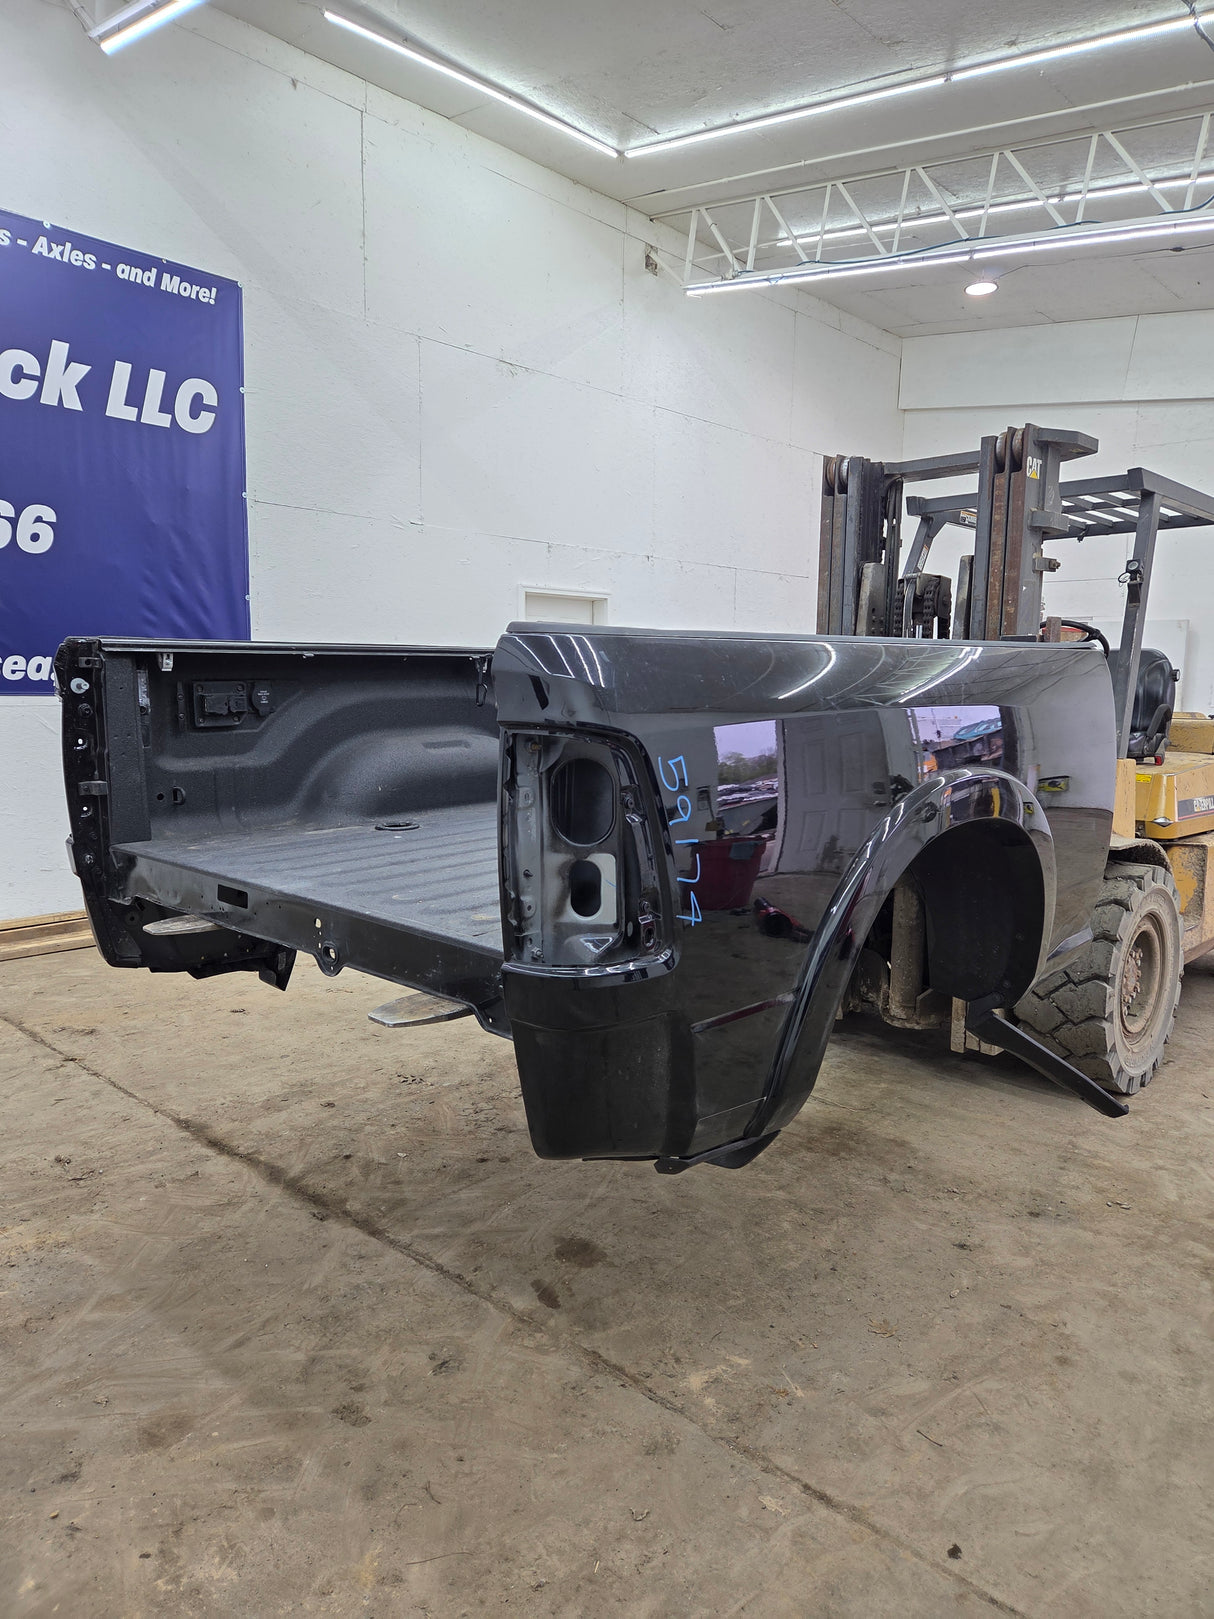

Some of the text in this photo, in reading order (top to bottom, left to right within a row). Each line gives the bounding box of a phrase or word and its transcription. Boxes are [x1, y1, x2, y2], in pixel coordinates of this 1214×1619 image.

[16, 238, 28, 247] -
[31, 235, 97, 270] Axles
[101, 262, 112, 270] -
[116, 263, 157, 287] and
[160, 272, 217, 305] More!
[0, 339, 218, 434] ck LLC
[1026, 456, 1043, 480] CAT
[658, 755, 702, 927] 59174
